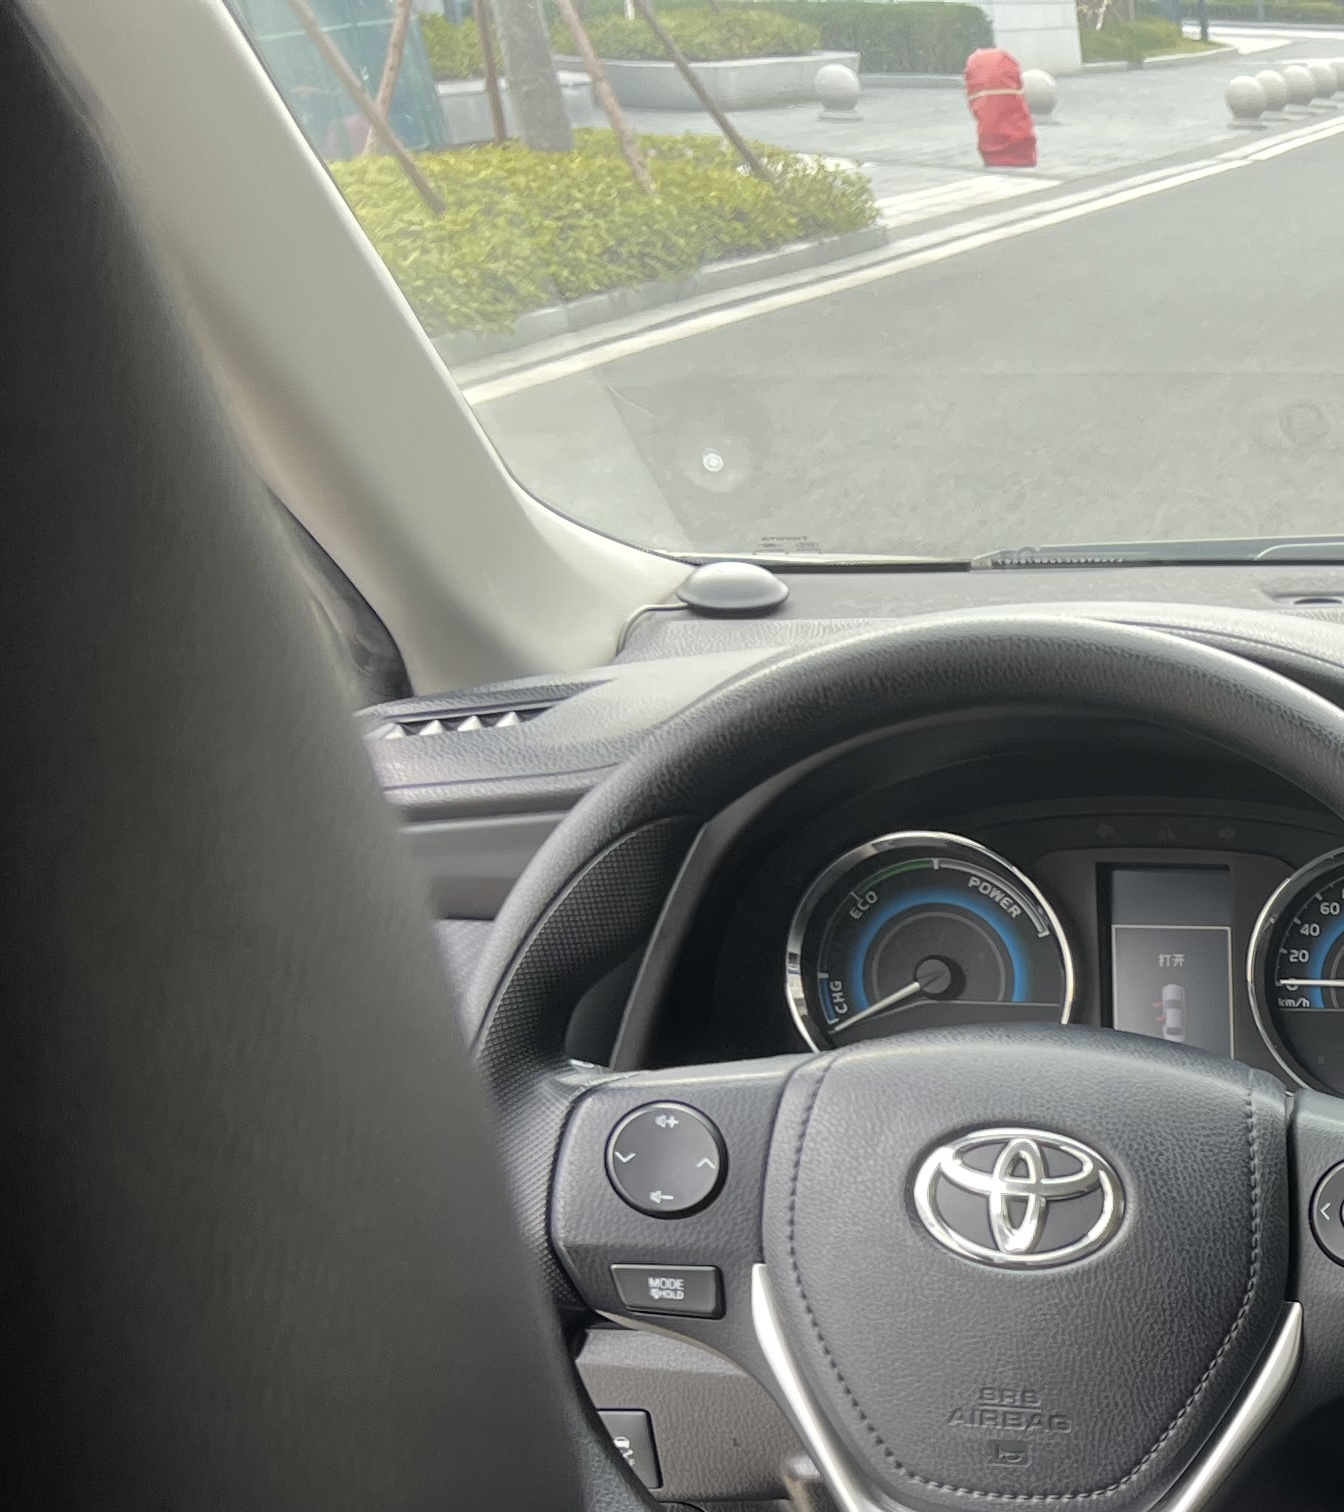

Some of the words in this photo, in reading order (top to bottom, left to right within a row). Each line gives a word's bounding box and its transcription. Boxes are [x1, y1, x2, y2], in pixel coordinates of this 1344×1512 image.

[968, 876, 1022, 919] POWER
[850, 890, 878, 920] ECO
[1320, 902, 1340, 915] 60
[1300, 923, 1320, 936] 40
[1158, 954, 1185, 968] 打开
[1289, 950, 1309, 962] 20
[829, 979, 848, 1015] CHG
[1278, 998, 1310, 1008] km/h
[648, 1277, 684, 1290] MODE
